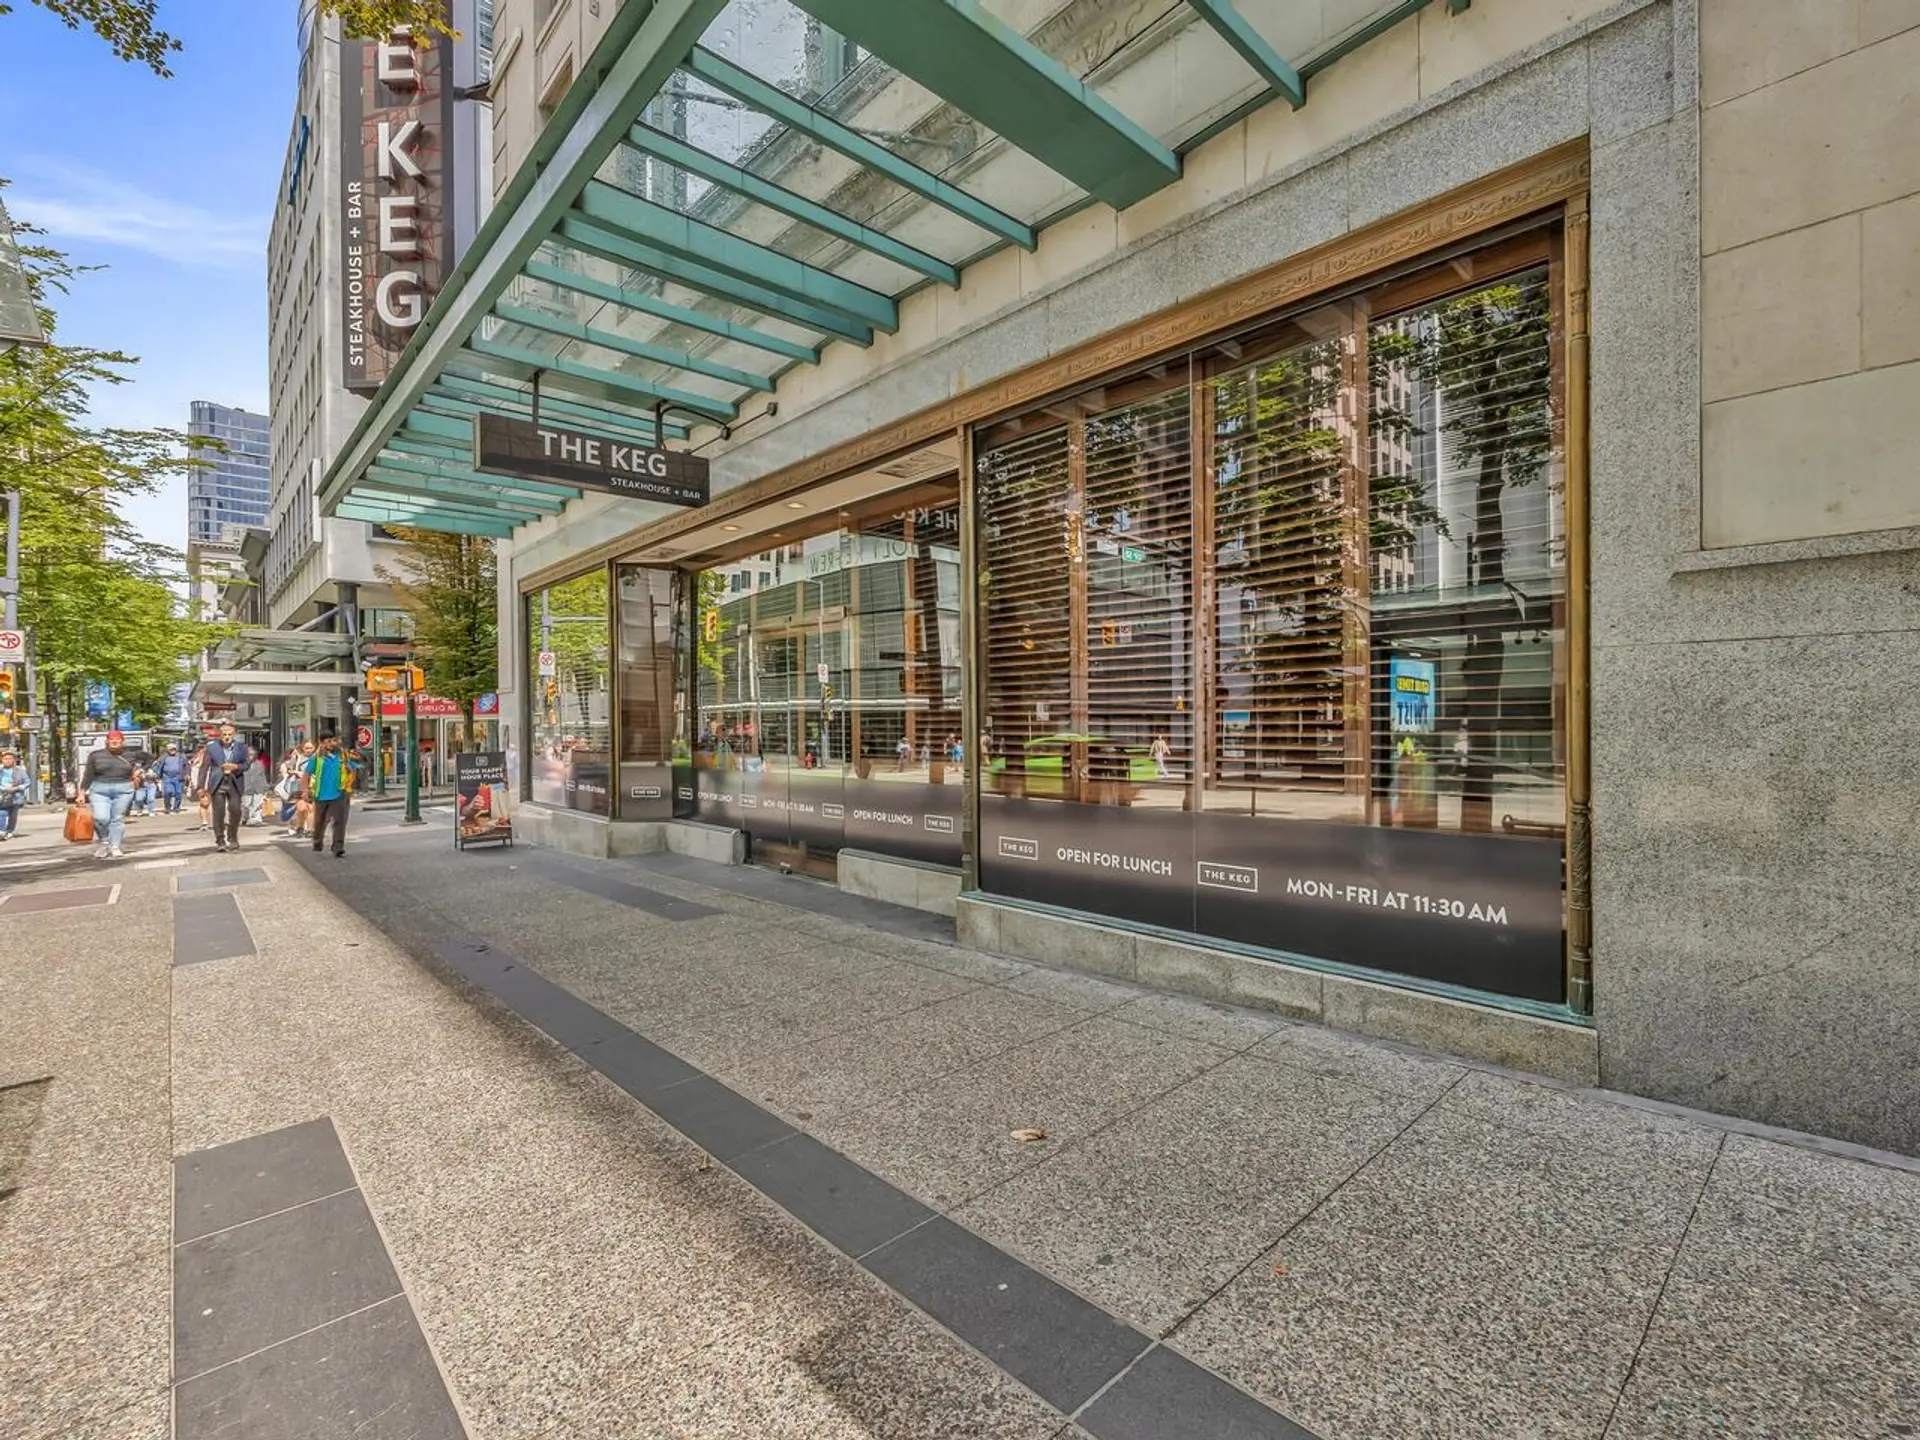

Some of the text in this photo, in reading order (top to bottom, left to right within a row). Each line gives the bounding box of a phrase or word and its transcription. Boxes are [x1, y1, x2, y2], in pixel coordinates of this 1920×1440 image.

[348, 181, 362, 219] BAR
[376, 121, 421, 327] KEG
[350, 245, 363, 366] STEAKHOUSE
[537, 429, 668, 478] THE KEG
[610, 476, 671, 496] STEAKHOUSE
[683, 489, 702, 500] BAR
[853, 809, 871, 821] OPEN
[873, 811, 887, 822] FOR
[888, 812, 914, 825] LUNCH
[1002, 843, 1018, 853] THE
[1056, 846, 1173, 877] OPEN FOR LUNCH
[1203, 870, 1252, 885] THE KEG
[1383, 889, 1410, 911] AT
